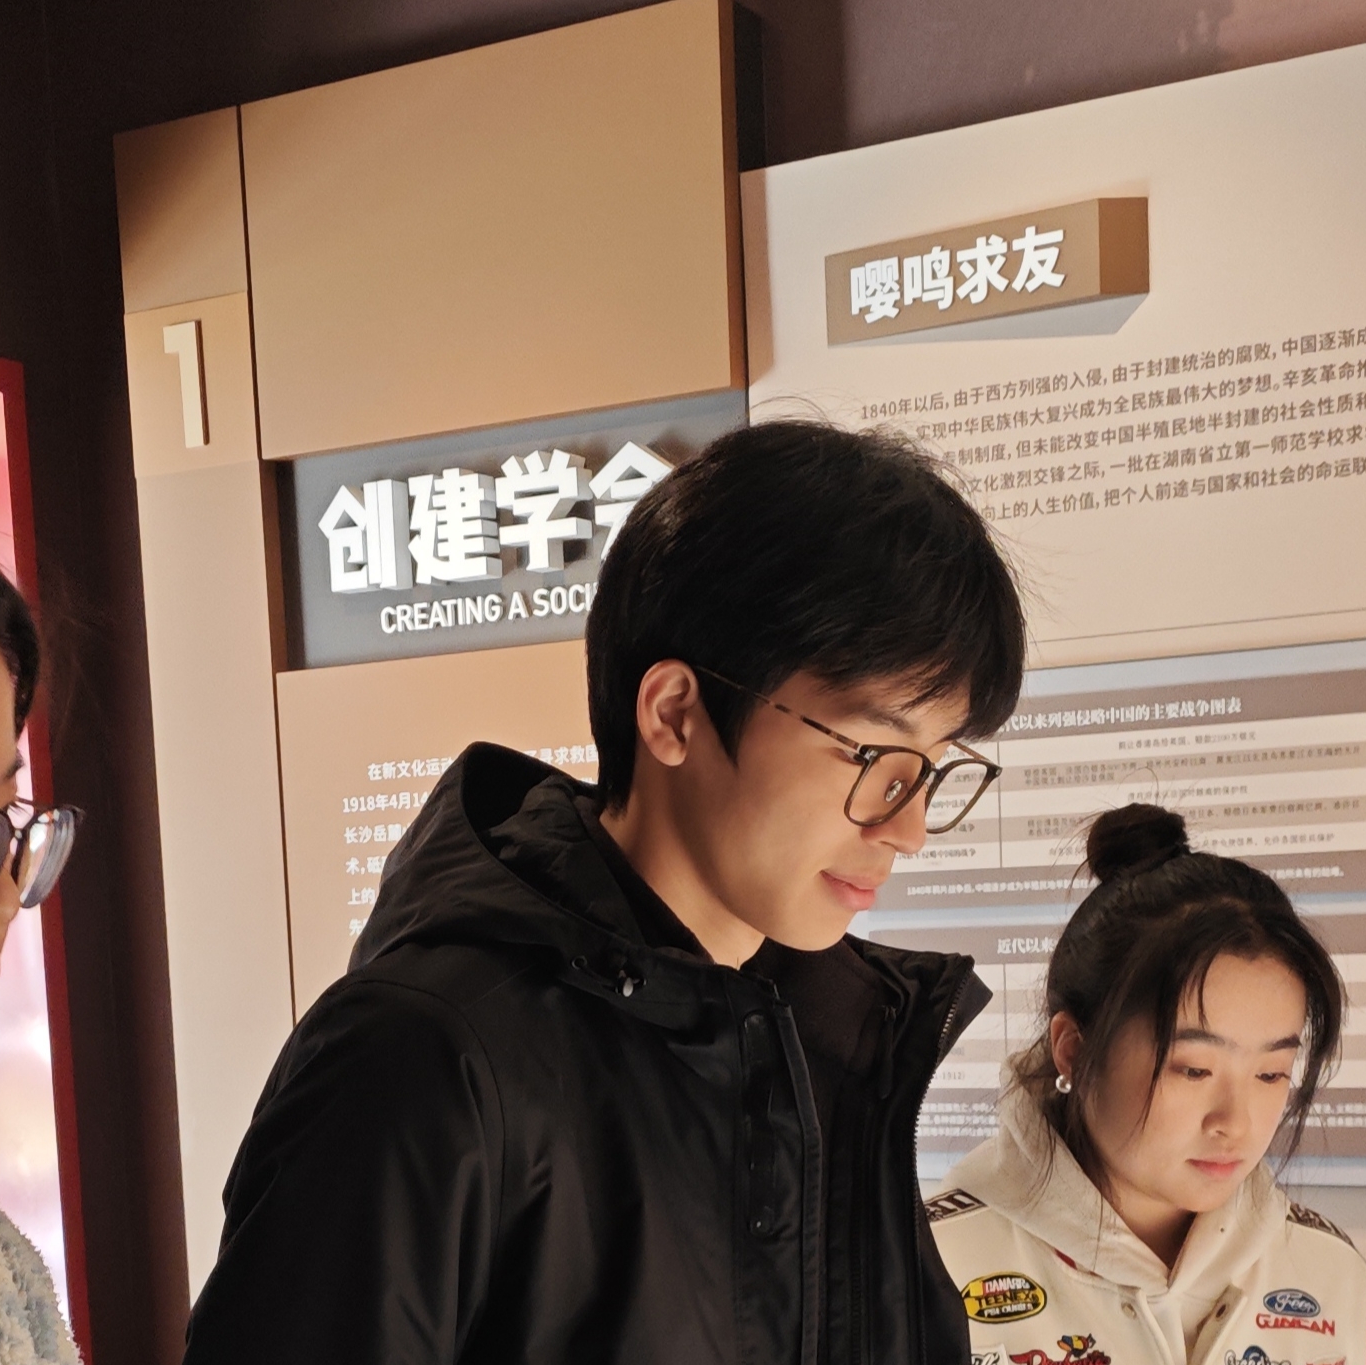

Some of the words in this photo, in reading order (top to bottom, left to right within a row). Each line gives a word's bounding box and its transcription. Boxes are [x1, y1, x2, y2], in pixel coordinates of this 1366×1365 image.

[849, 225, 1066, 323] 嘤鸣求友
[163, 320, 209, 448] 1
[380, 593, 503, 634] CREATING
[508, 591, 529, 620] A
[533, 582, 598, 617] SOCI
